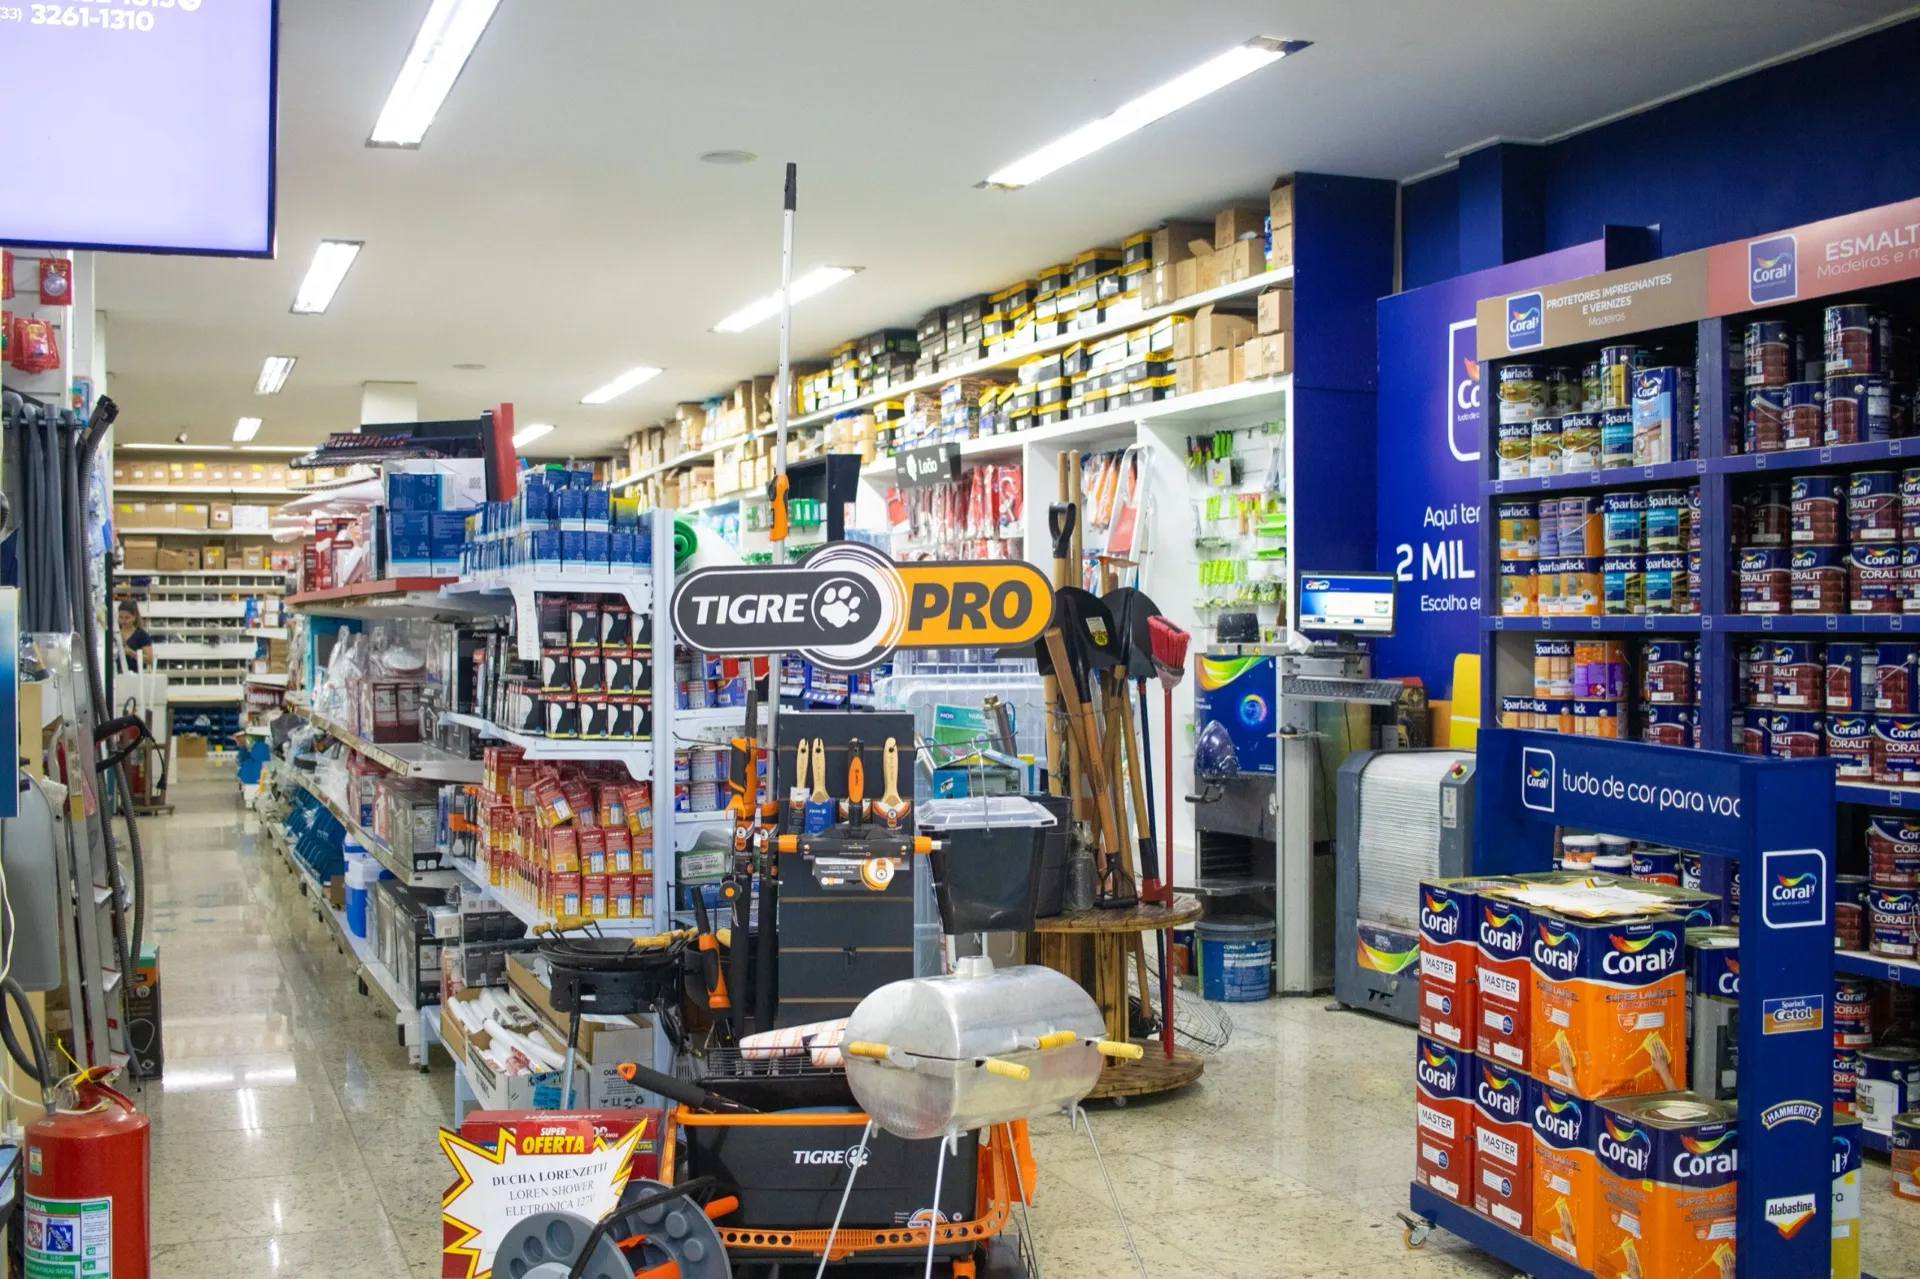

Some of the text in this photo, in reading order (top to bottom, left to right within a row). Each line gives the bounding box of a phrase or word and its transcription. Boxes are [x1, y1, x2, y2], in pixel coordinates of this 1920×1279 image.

[31, 4, 154, 31] 3261-1310
[1826, 225, 1920, 262] ESMALT
[1753, 264, 1788, 284] Coral
[1817, 252, 1890, 279] Madeiras
[1893, 251, 1904, 263] e
[1546, 273, 1672, 310] PROTETORES IMPREGNANTES
[1582, 296, 1632, 315] E VERNIZES
[1510, 319, 1536, 334] Coral
[1423, 504, 1457, 531] Aqui
[1396, 540, 1475, 582] 2 MIL
[1741, 558, 1763, 569] Coral
[1865, 554, 1895, 565] Coral
[691, 579, 1033, 631] TIGRE PRO
[1420, 594, 1468, 612] Escolha
[1535, 643, 1570, 655] Sparlack
[1833, 724, 1861, 735] Coral
[1890, 727, 1920, 739] Coral
[1829, 739, 1871, 748] CORALIT
[1527, 774, 1547, 789] Coral
[1562, 768, 1599, 796] tudo
[1602, 775, 1625, 800] de
[1627, 783, 1657, 804] cor
[1660, 787, 1704, 812] para
[1772, 885, 1810, 900] Coral
[1878, 899, 1907, 911] Coral
[1421, 906, 1453, 935] Coral
[1480, 921, 1516, 952] Coral
[1425, 956, 1454, 975] MASTER
[1534, 939, 1573, 972] Coral
[1603, 949, 1666, 975] Coral
[1484, 973, 1517, 993] MASTER
[1782, 999, 1806, 1009] Sparlack
[1836, 991, 1864, 1002] Coral
[1773, 1007, 1813, 1022] Cetol
[1418, 1060, 1450, 1091] Coral
[1478, 1082, 1514, 1115] Coral
[1421, 1109, 1452, 1130] MASTER
[1535, 1105, 1573, 1141] Coral
[1767, 1104, 1816, 1124] HAMMERITE
[541, 1127, 566, 1136] SUPER
[522, 1136, 585, 1154] OFERTA
[1482, 1133, 1515, 1157] MASTER
[1598, 1132, 1642, 1171] Coral
[793, 1150, 846, 1164] TIGRE
[1673, 1149, 1737, 1177] Coral
[492, 1162, 608, 1187] DUCHA LORENZETTI
[509, 1180, 594, 1201] LOREN SHOWER
[1768, 1200, 1812, 1216] Alabastine
